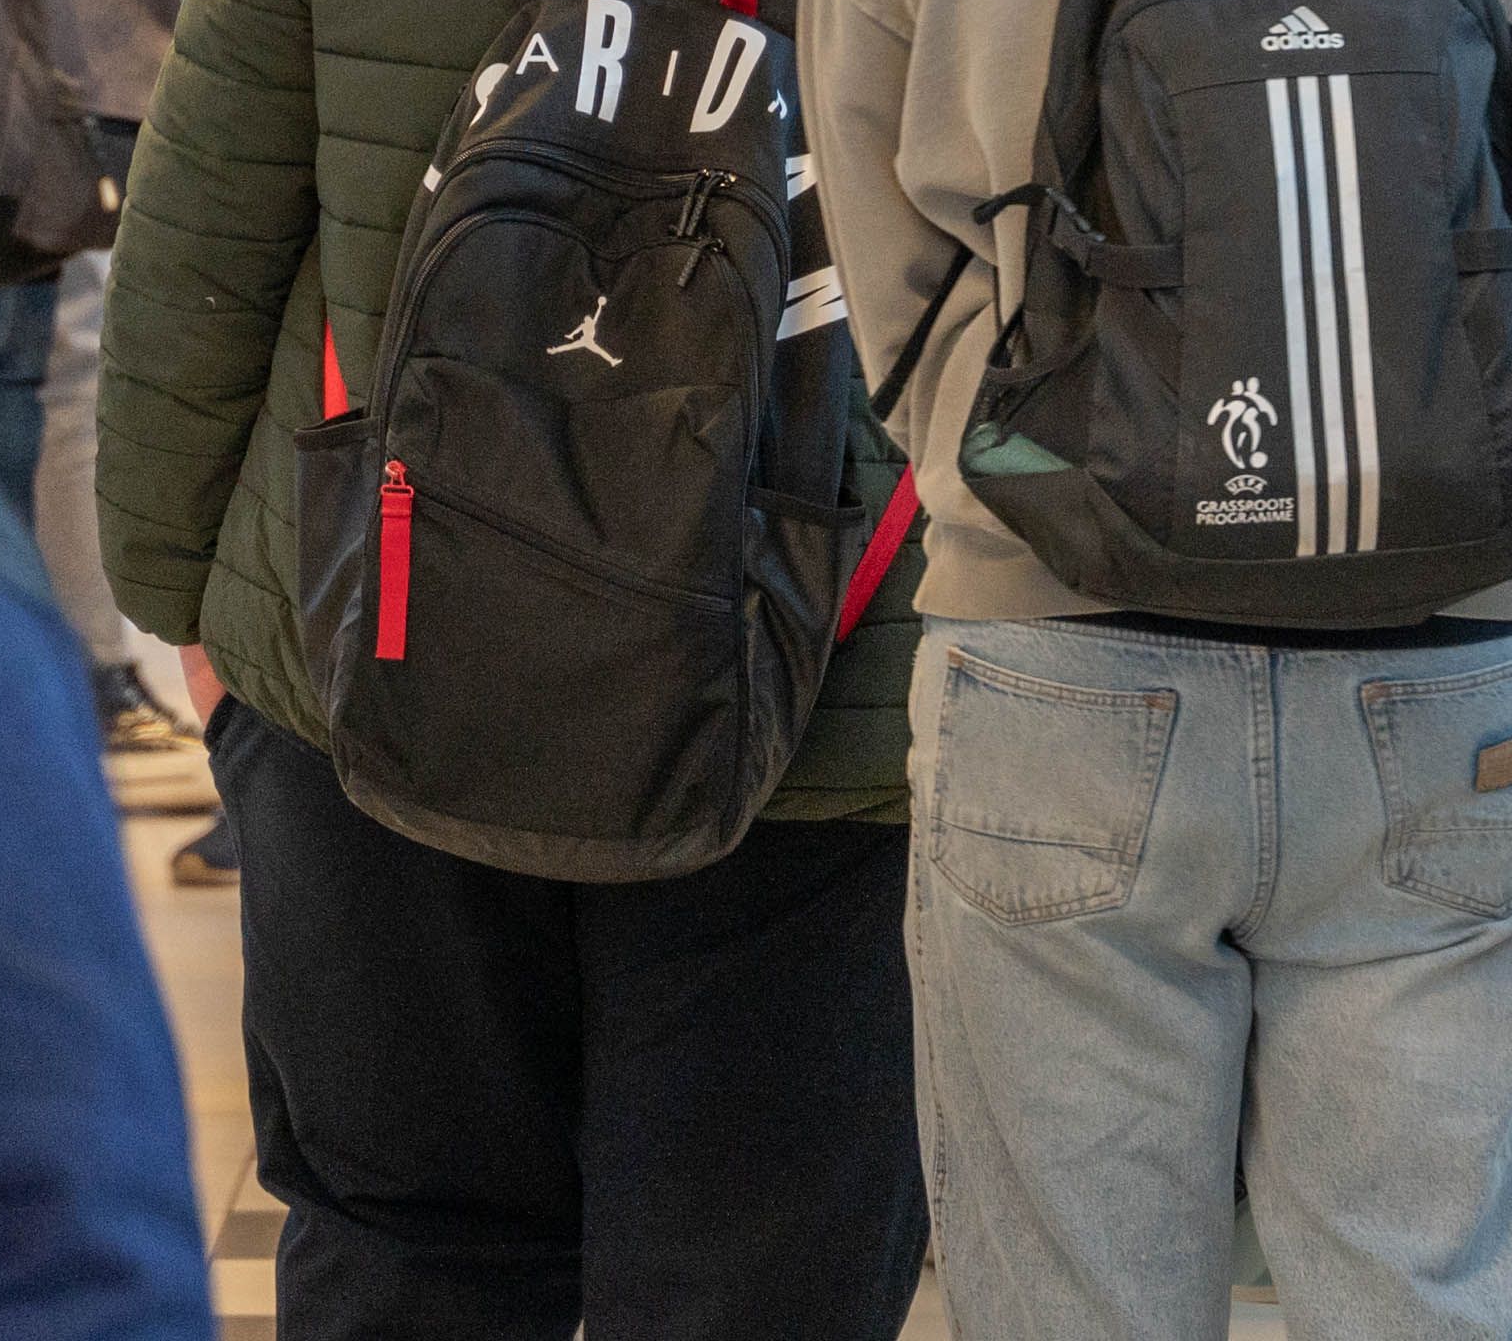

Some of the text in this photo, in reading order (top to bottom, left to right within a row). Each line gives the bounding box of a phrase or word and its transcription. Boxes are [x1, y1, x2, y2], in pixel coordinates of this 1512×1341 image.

[1260, 30, 1345, 52] adidas
[1196, 497, 1295, 514] GRASSROOTS
[1195, 510, 1295, 526] PROGRAMME
